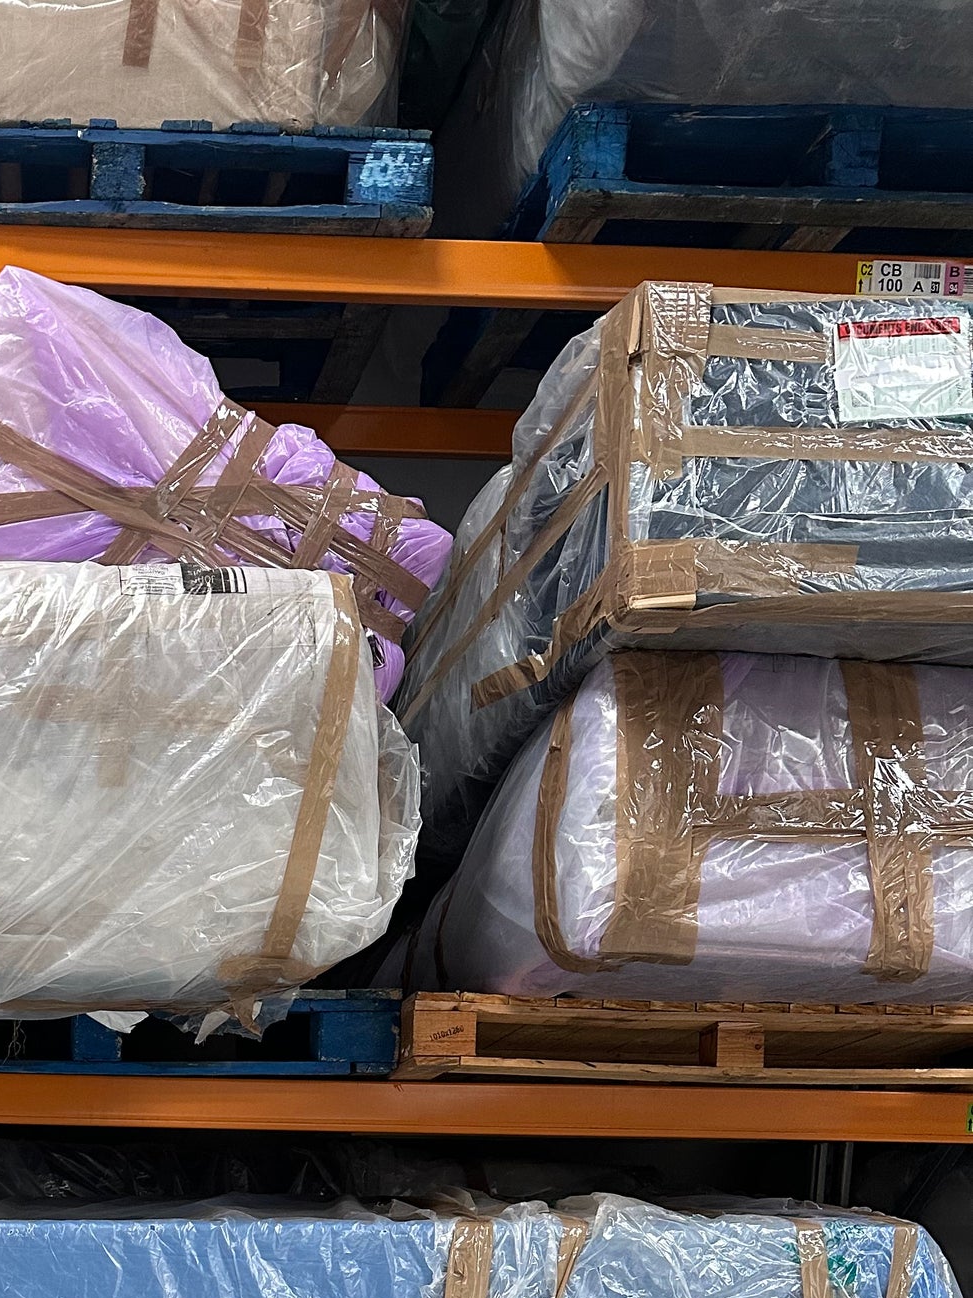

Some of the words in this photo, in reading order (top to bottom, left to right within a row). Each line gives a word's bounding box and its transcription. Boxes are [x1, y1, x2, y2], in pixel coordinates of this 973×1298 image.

[881, 263, 901, 276] CB
[950, 267, 960, 277] B
[878, 279, 902, 292] 100
[913, 281, 923, 292] A
[845, 321, 902, 336] CUMENTS
